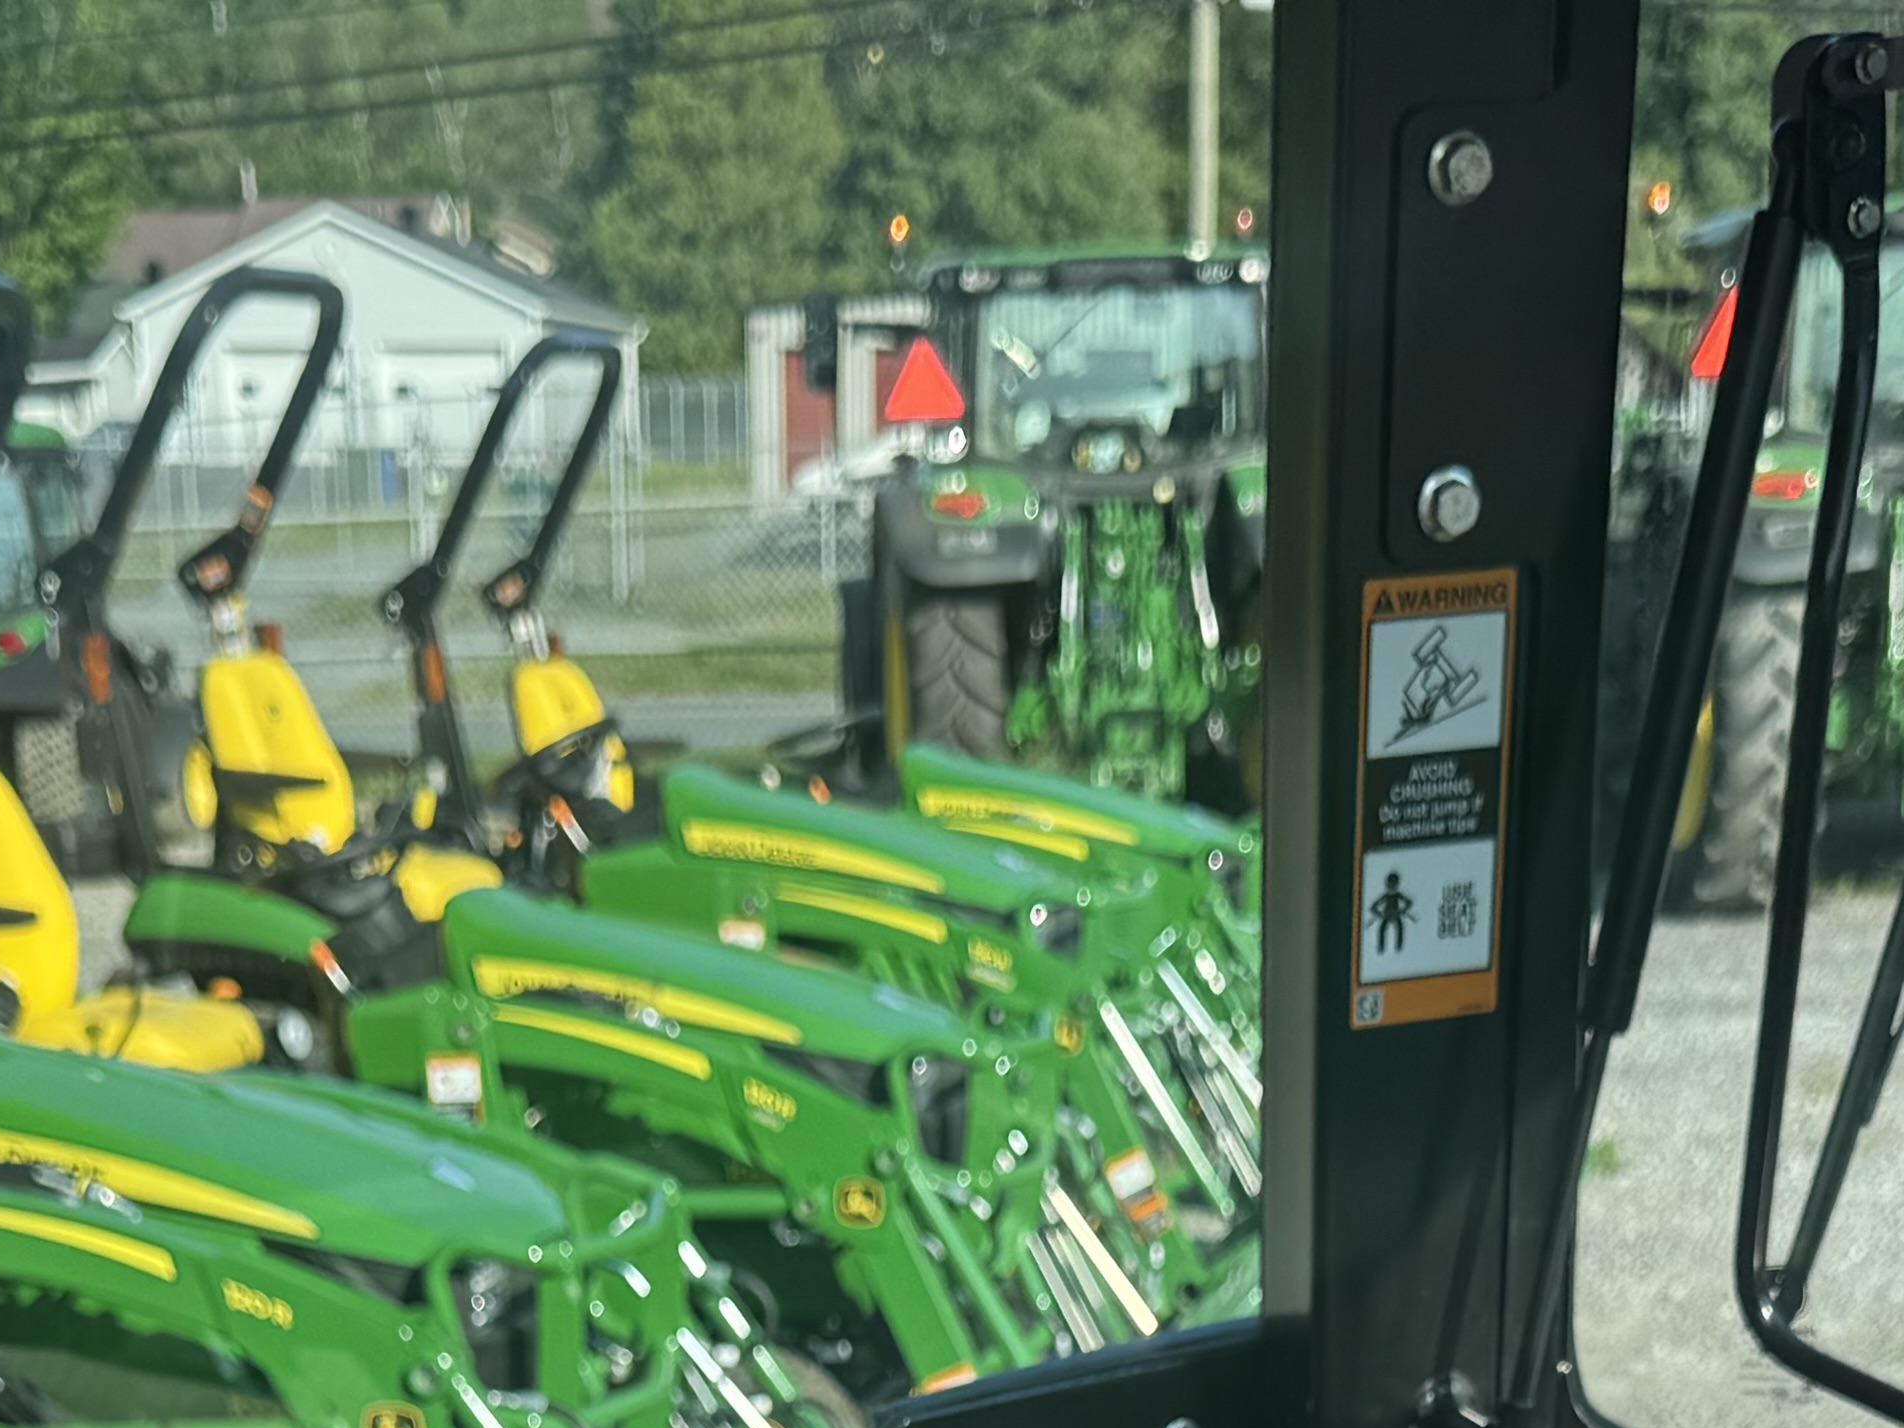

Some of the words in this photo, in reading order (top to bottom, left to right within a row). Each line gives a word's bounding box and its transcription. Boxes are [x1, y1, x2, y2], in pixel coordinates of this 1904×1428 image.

[1398, 583, 1508, 612] WARNING
[1408, 761, 1459, 782] AVOID
[1390, 778, 1474, 804] CRUSHING
[1383, 818, 1445, 841] machine
[1438, 899, 1476, 920] SEAT
[1437, 919, 1476, 939] BELT
